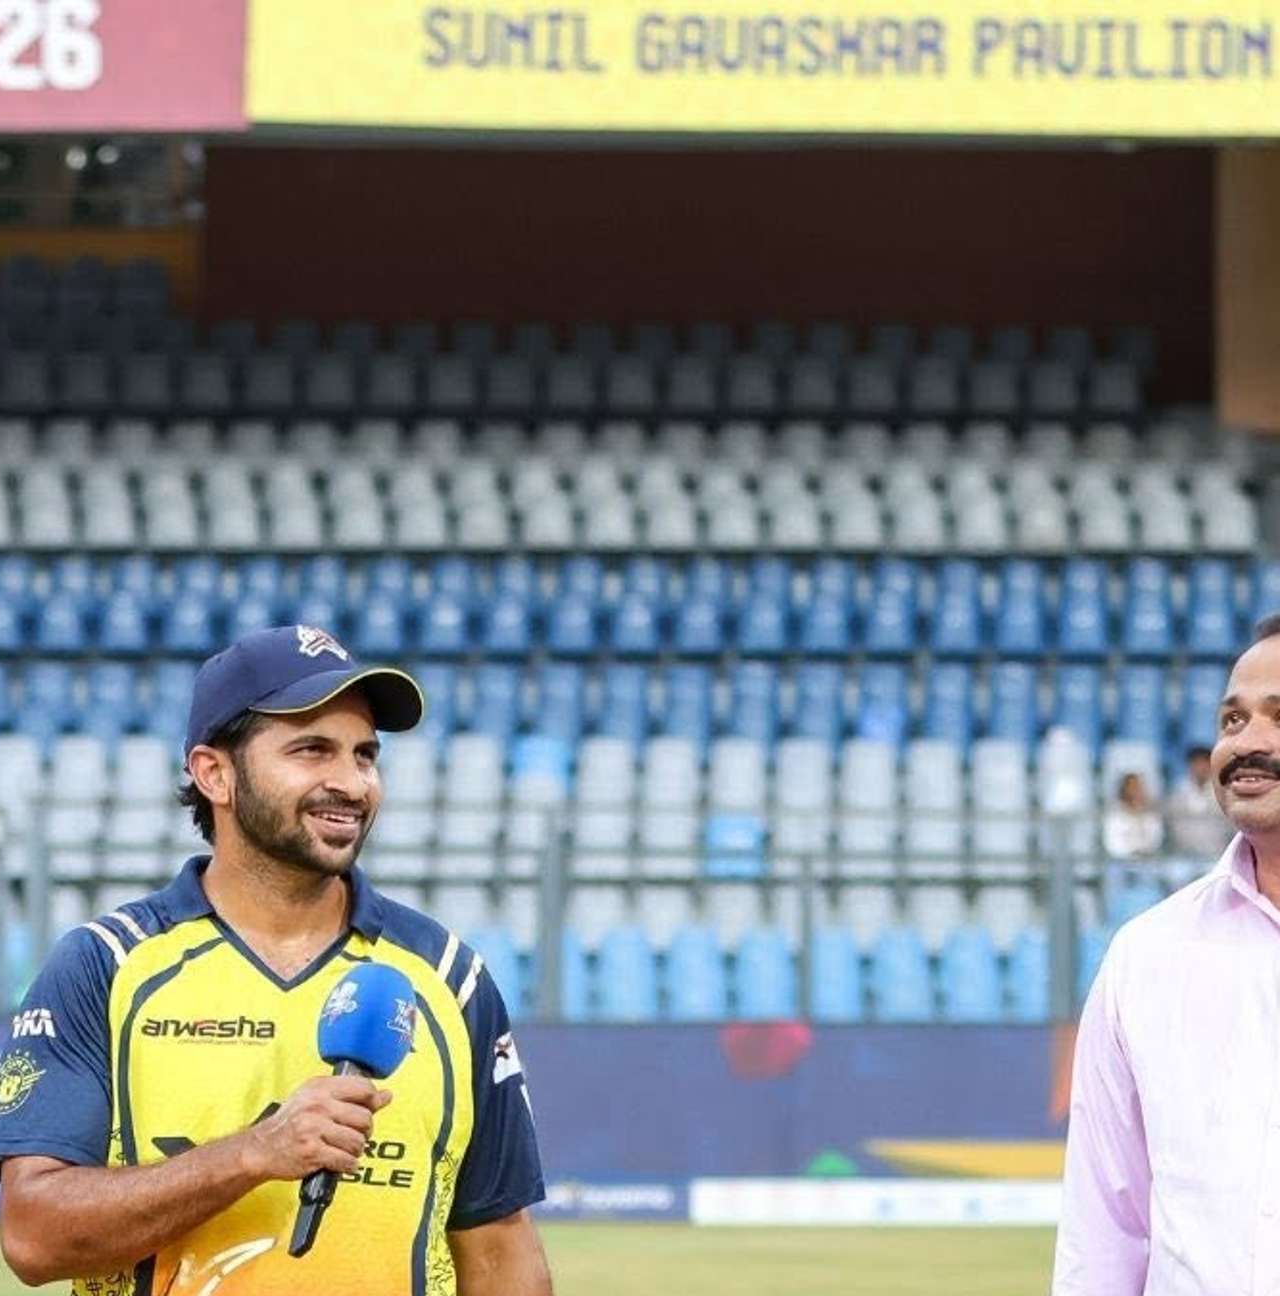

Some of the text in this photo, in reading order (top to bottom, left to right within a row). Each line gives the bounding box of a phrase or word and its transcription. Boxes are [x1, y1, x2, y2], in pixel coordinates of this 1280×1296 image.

[423, 10, 1274, 79] SUNIL GAVASKAR PAVILION
